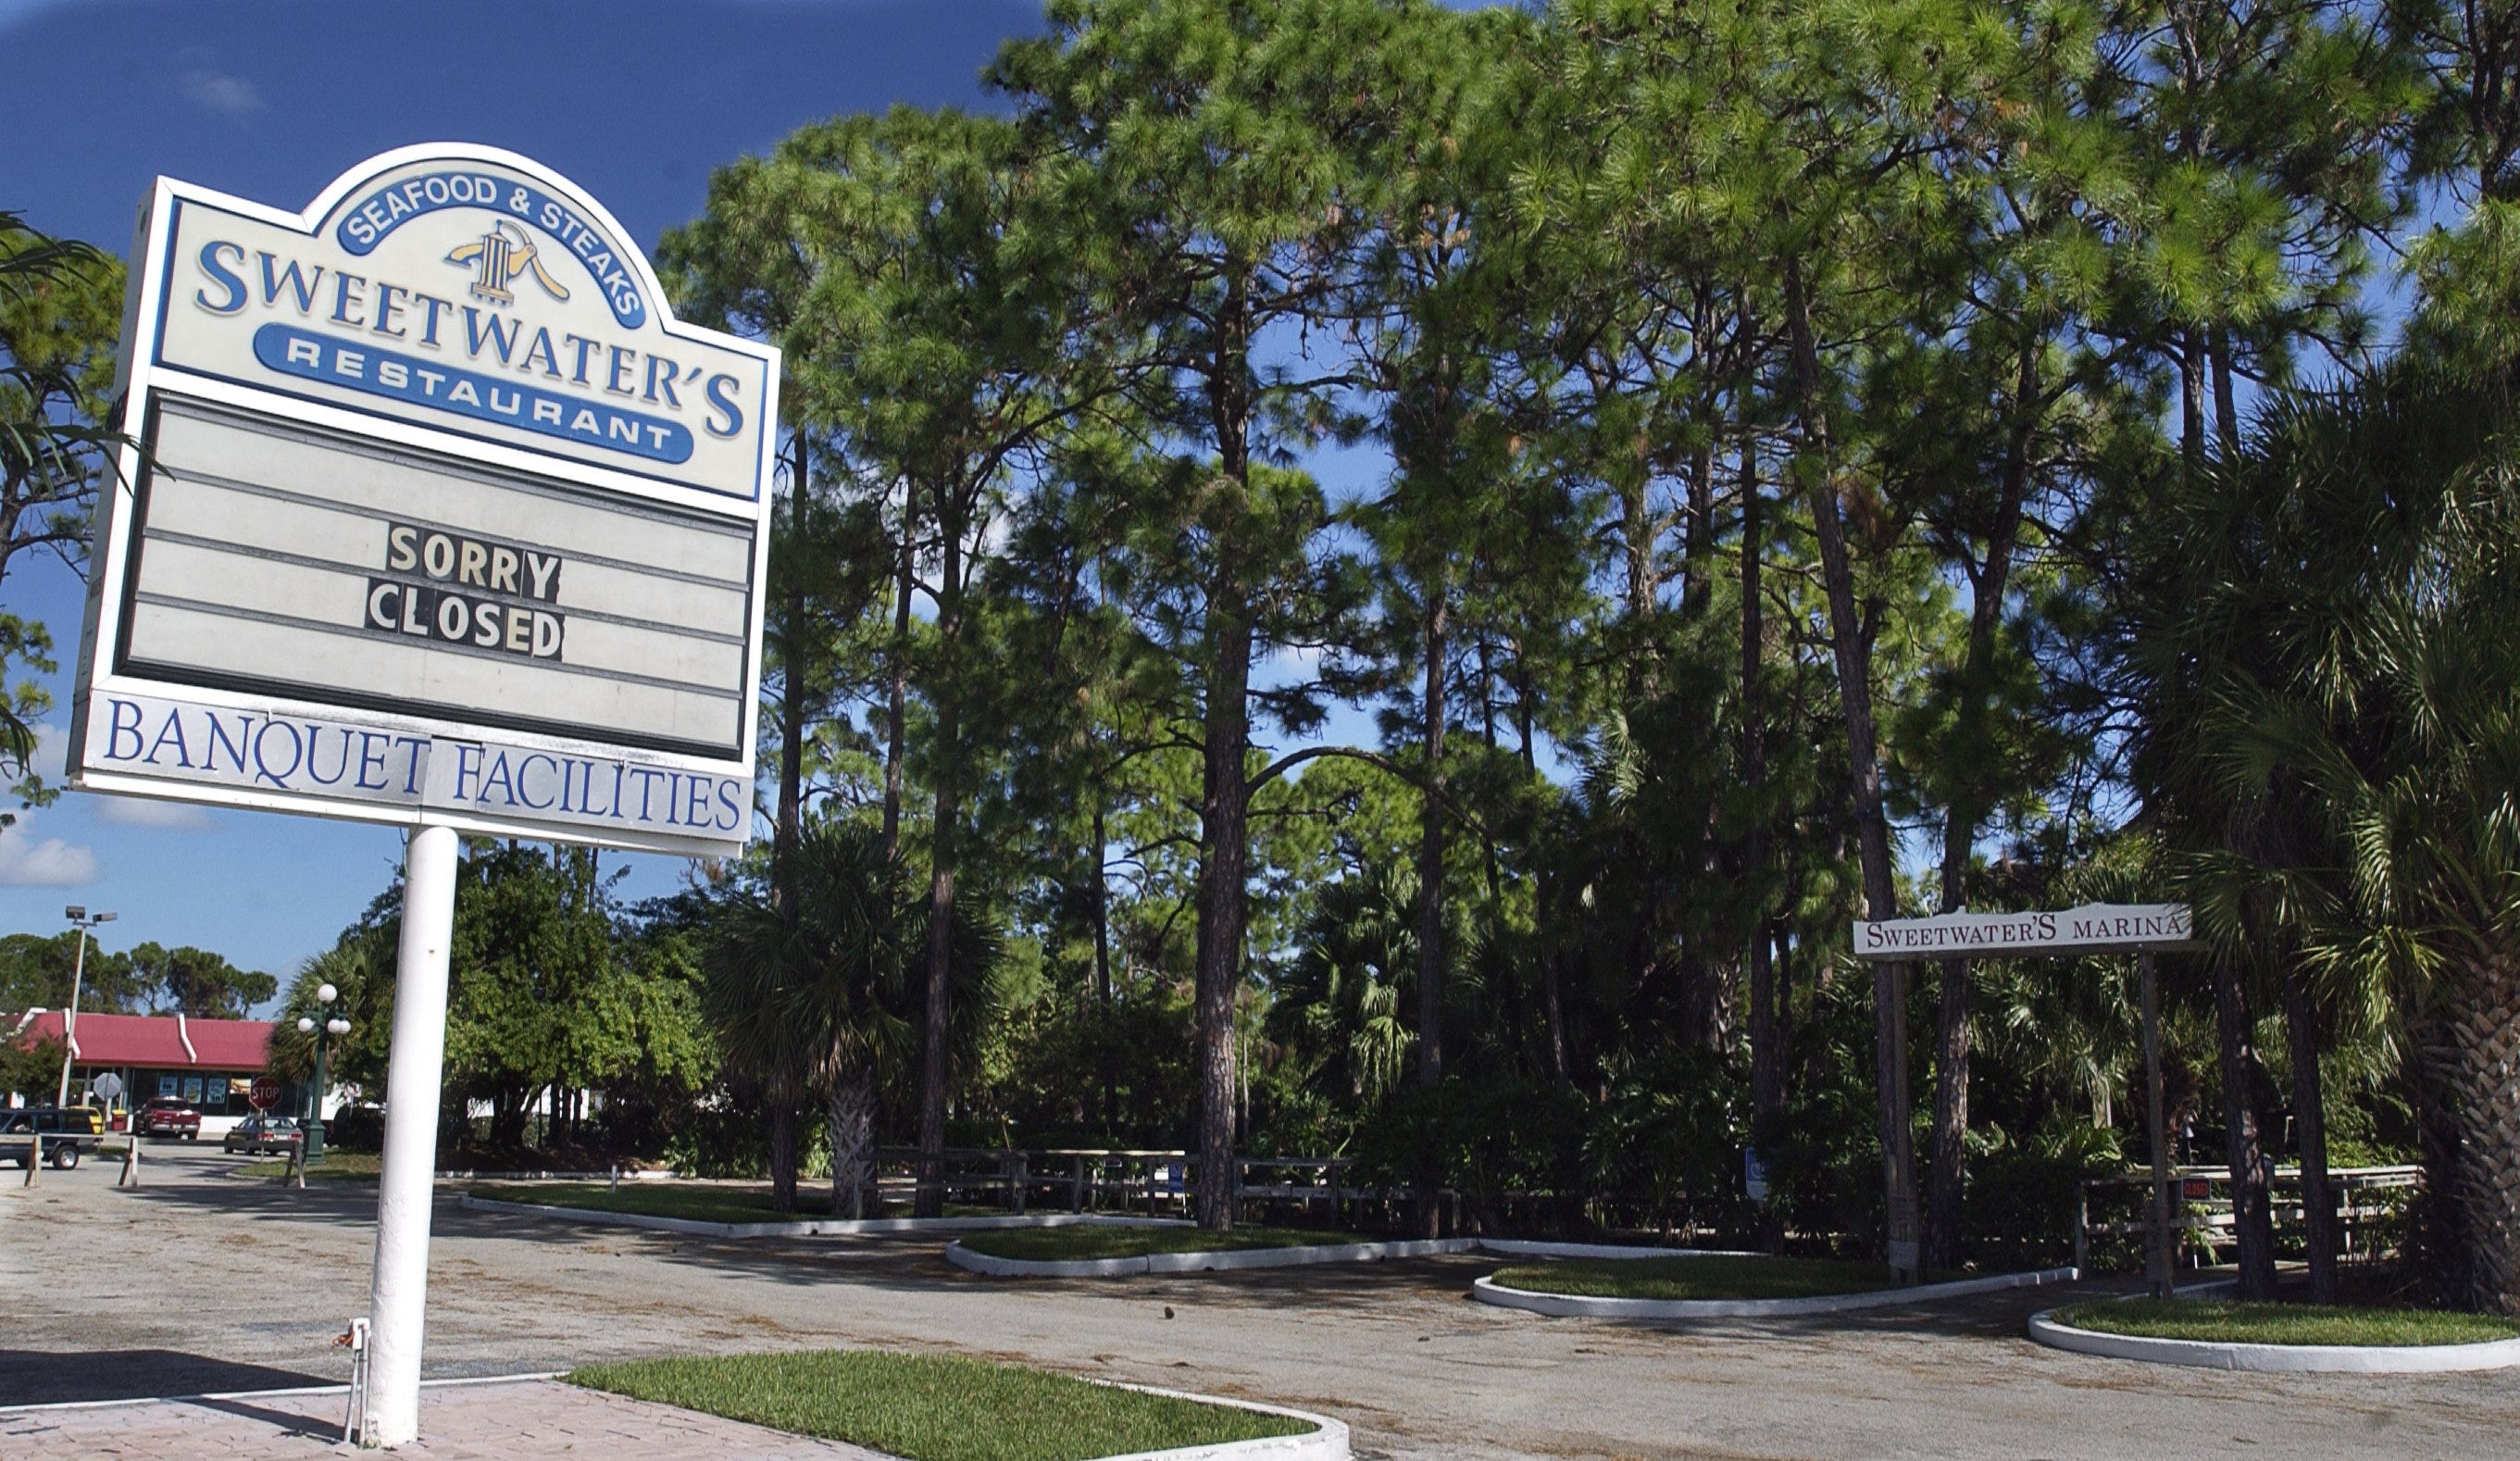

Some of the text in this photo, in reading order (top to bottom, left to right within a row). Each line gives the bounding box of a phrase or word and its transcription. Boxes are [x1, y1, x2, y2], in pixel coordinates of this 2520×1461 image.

[346, 175, 640, 317] SEAFOOD & STEAKS
[286, 337, 673, 451] RESTAURANT
[390, 528, 559, 599] SORRY
[369, 584, 560, 658] CLOSED
[103, 699, 741, 832] BANQUET FACILITIES
[2073, 916, 2184, 939] MARINA
[252, 1086, 279, 1099] STOP
